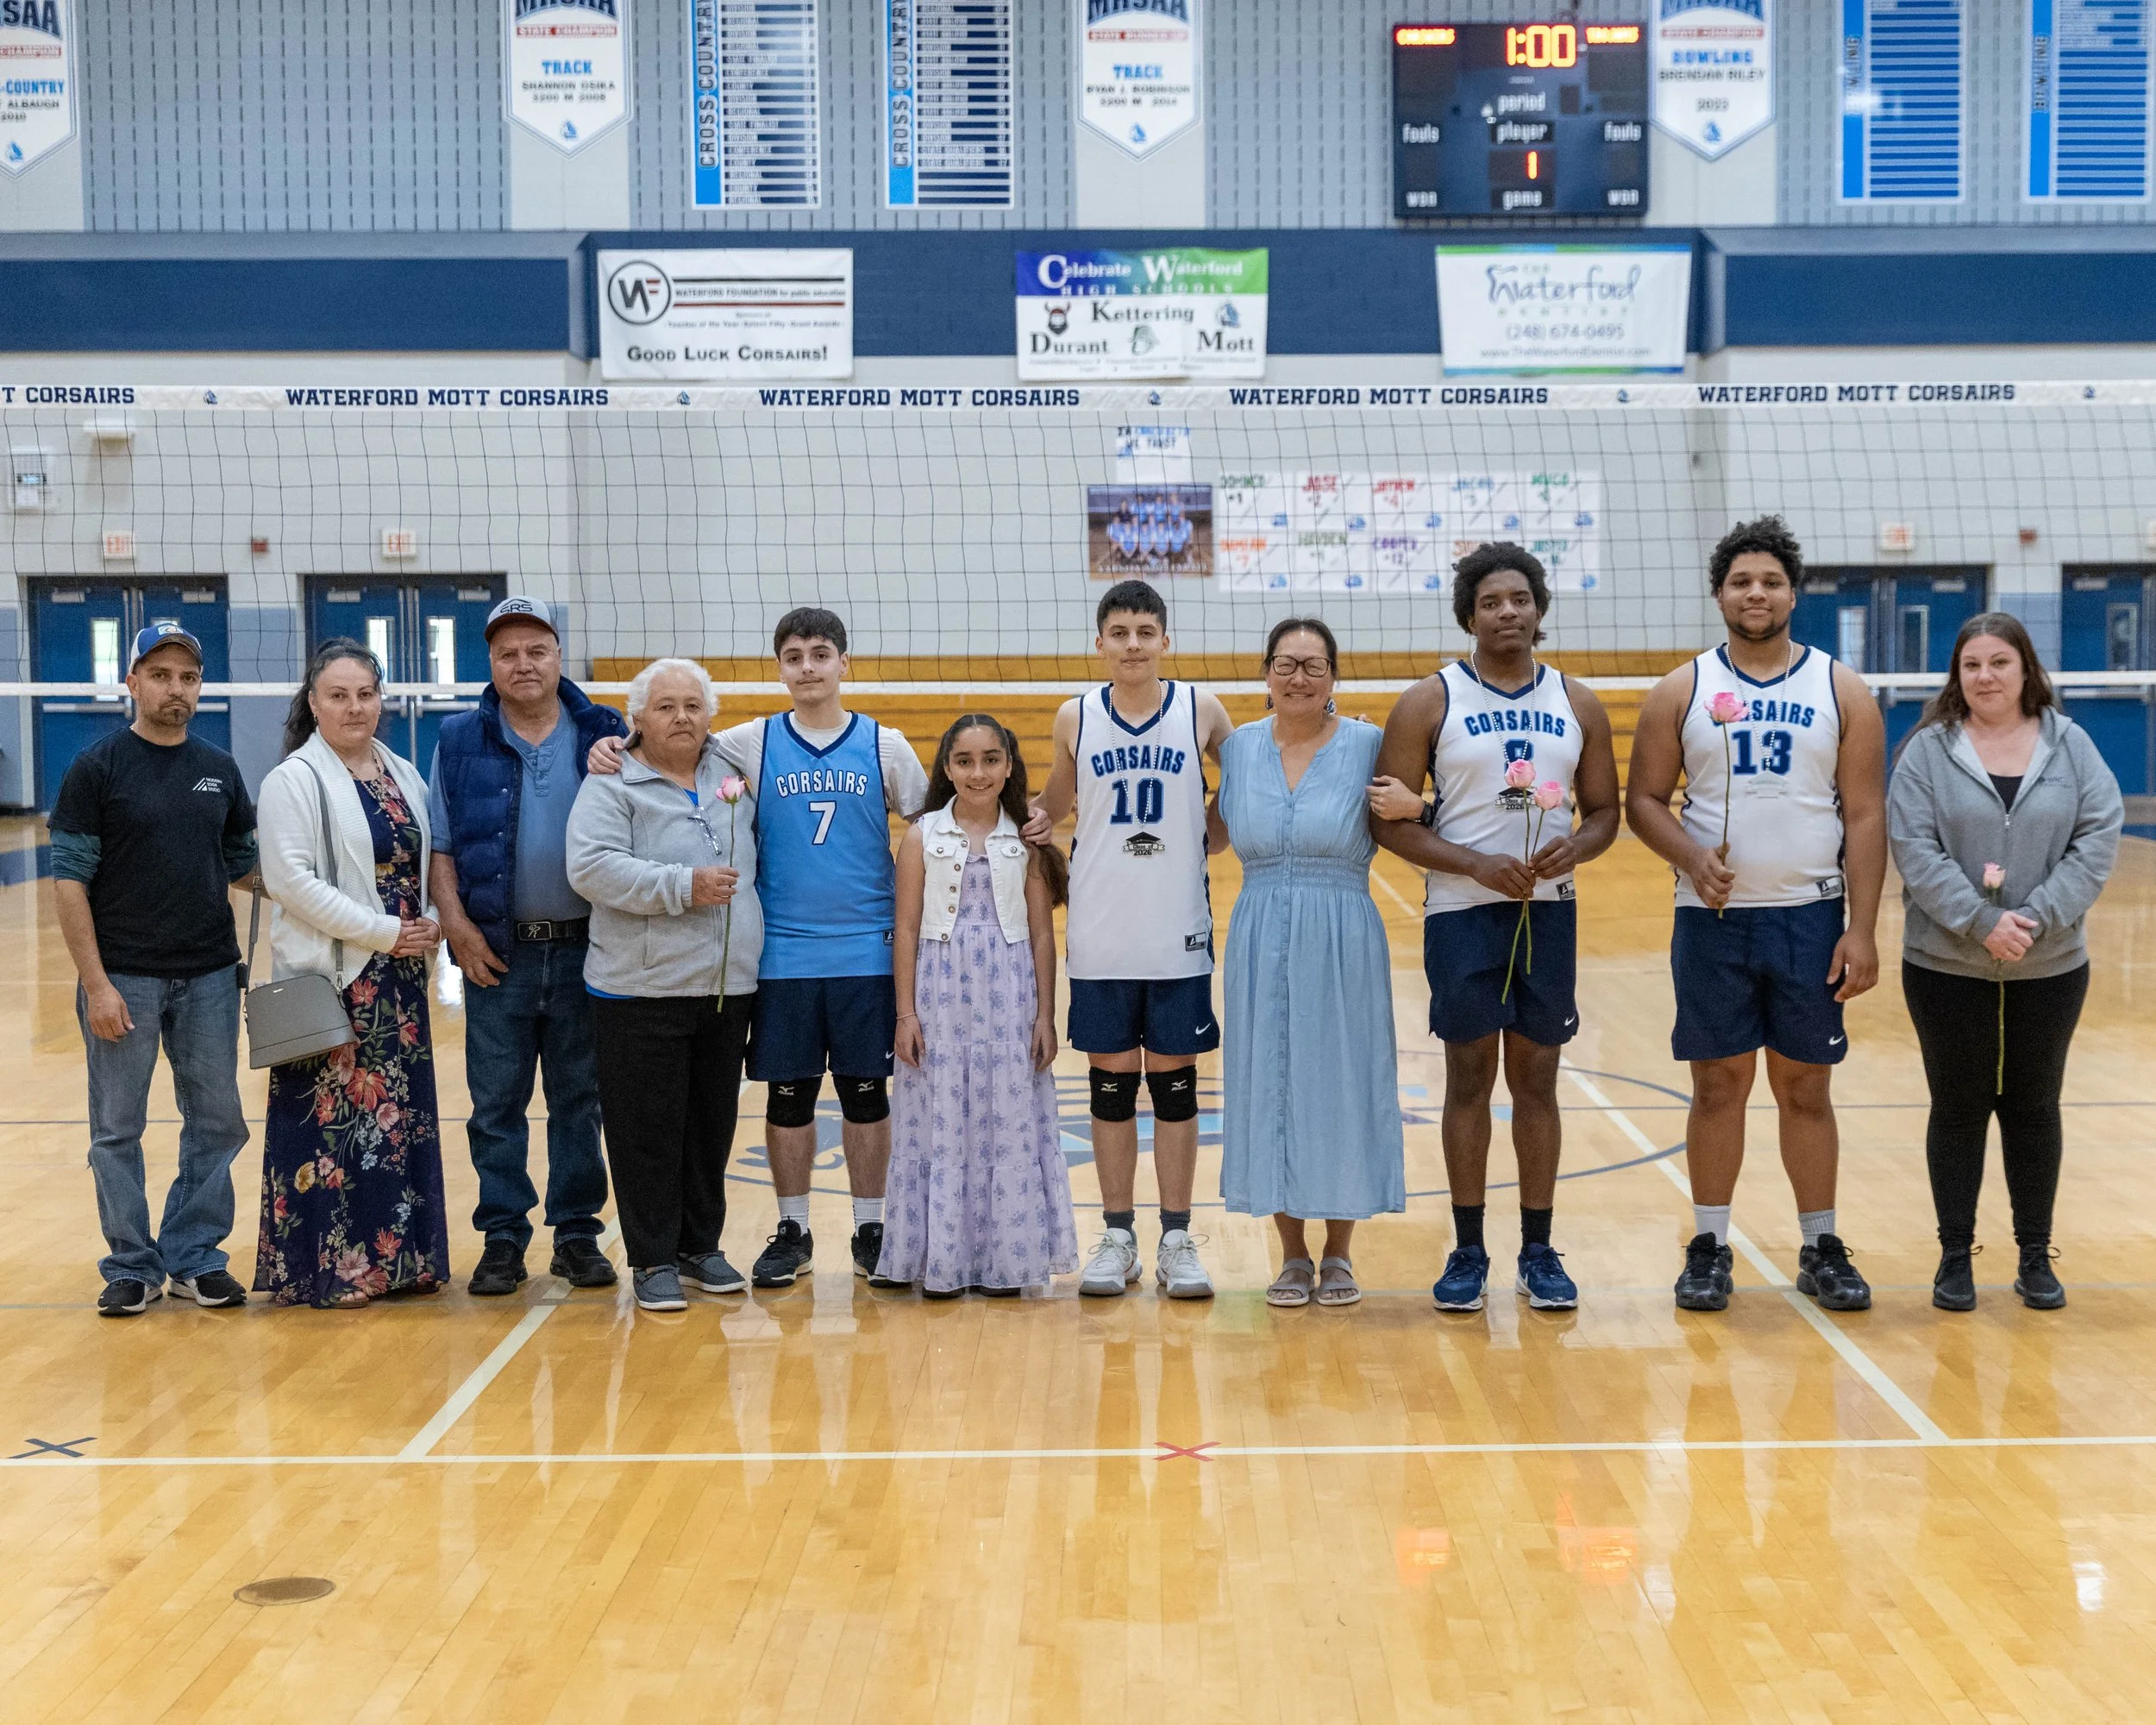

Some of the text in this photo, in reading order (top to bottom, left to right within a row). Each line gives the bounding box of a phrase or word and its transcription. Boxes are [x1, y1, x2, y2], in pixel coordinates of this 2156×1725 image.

[1507, 25, 1576, 67] 1:00
[542, 60, 592, 74] TRACK
[1113, 66, 1163, 78] TRACK
[522, 81, 576, 90] SHANNON
[1497, 91, 1545, 115] period
[1496, 120, 1548, 144] player
[1527, 151, 1538, 179] 1
[1502, 191, 1542, 210] game
[1038, 254, 1243, 288] Celebrate Waterford
[1486, 264, 1642, 304] Waterford
[1092, 301, 1194, 324] Kettering
[1030, 332, 1110, 355] Durant
[1197, 329, 1254, 352] Mott
[2, 386, 135, 404] T CORSAIRS
[286, 389, 609, 406] WATERFORD MOTT CORSAIRS
[759, 389, 1080, 406] WATERFORD MOTT CORSAIRS
[1229, 387, 1548, 405] WATERFORD MOTT CORSAIRS
[1698, 384, 2015, 403] WATERFORD MOTT CORSAIRS
[1464, 709, 1565, 737] CORSAIRS
[1090, 744, 1186, 777] CORSAIRS
[1732, 730, 1792, 776] 13
[775, 769, 868, 799] CORSAIRS
[1110, 777, 1164, 825] 10
[808, 800, 837, 845] 7
